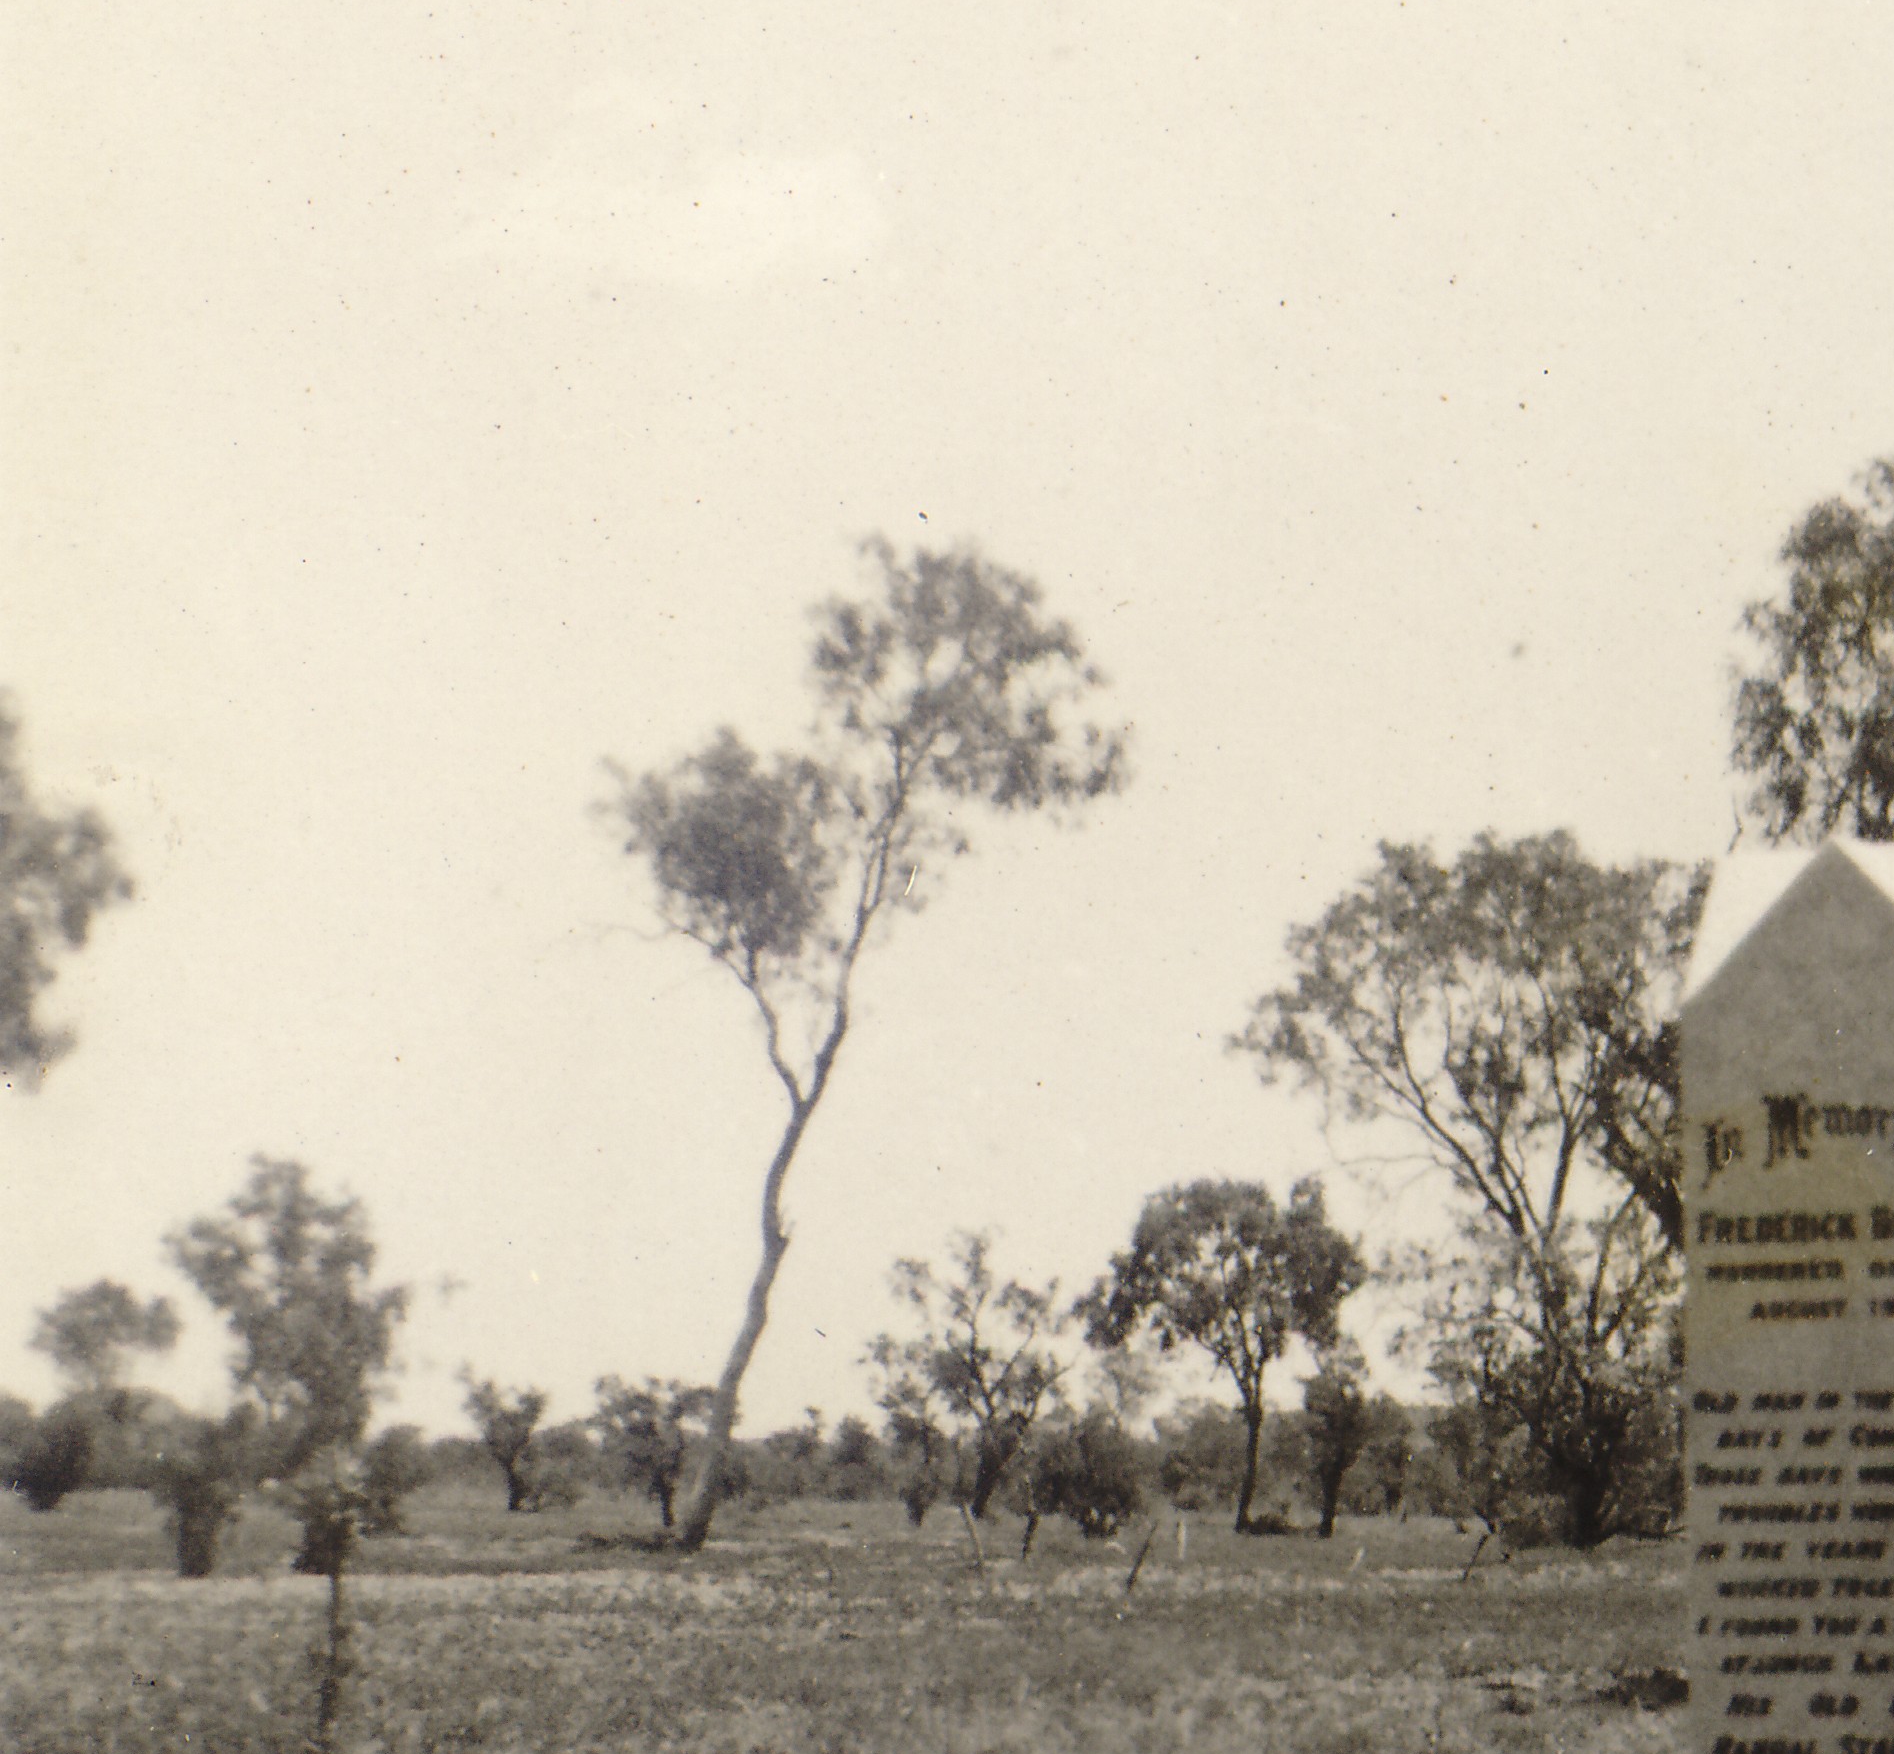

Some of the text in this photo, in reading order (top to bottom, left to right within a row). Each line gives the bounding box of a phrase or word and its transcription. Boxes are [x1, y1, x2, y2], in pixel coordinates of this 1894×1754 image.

[1701, 1118, 1744, 1189] In
[1697, 1210, 1858, 1245] FREDERICK
[1705, 1259, 1844, 1283] MURDERED
[1749, 1298, 1847, 1321] AUGUST
[1692, 1390, 1739, 1415] OLD
[1751, 1392, 1807, 1413] MAN
[1809, 1694, 1859, 1717] OLD
